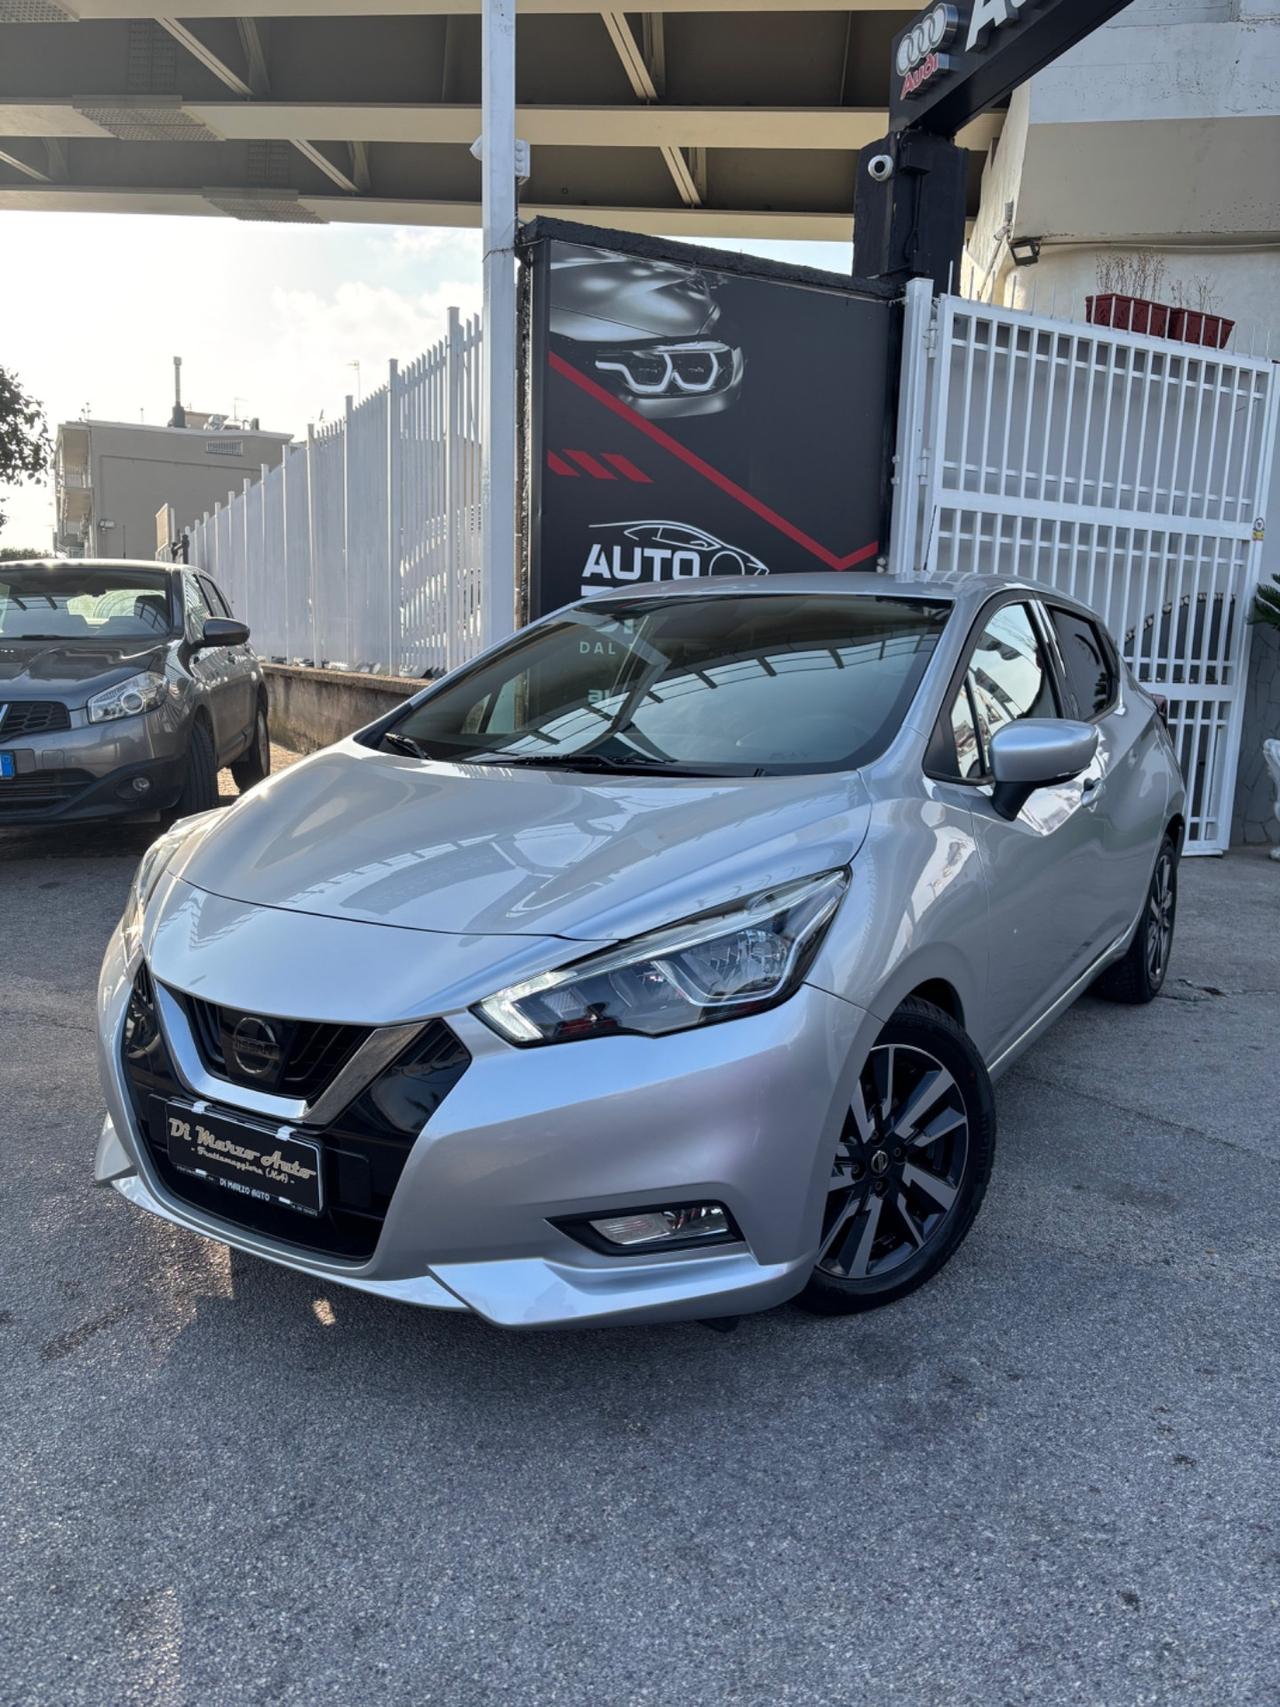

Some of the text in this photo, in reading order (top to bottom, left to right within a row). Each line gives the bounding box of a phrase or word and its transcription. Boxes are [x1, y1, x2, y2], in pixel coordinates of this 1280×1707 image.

[900, 52, 940, 101] Audi
[581, 543, 701, 581] AUTO
[579, 641, 616, 655] DAL
[195, 1124, 260, 1161] Marzo
[260, 1150, 317, 1180] Auto
[227, 1180, 250, 1196] MARZO
[251, 1188, 271, 1201] AUTO
